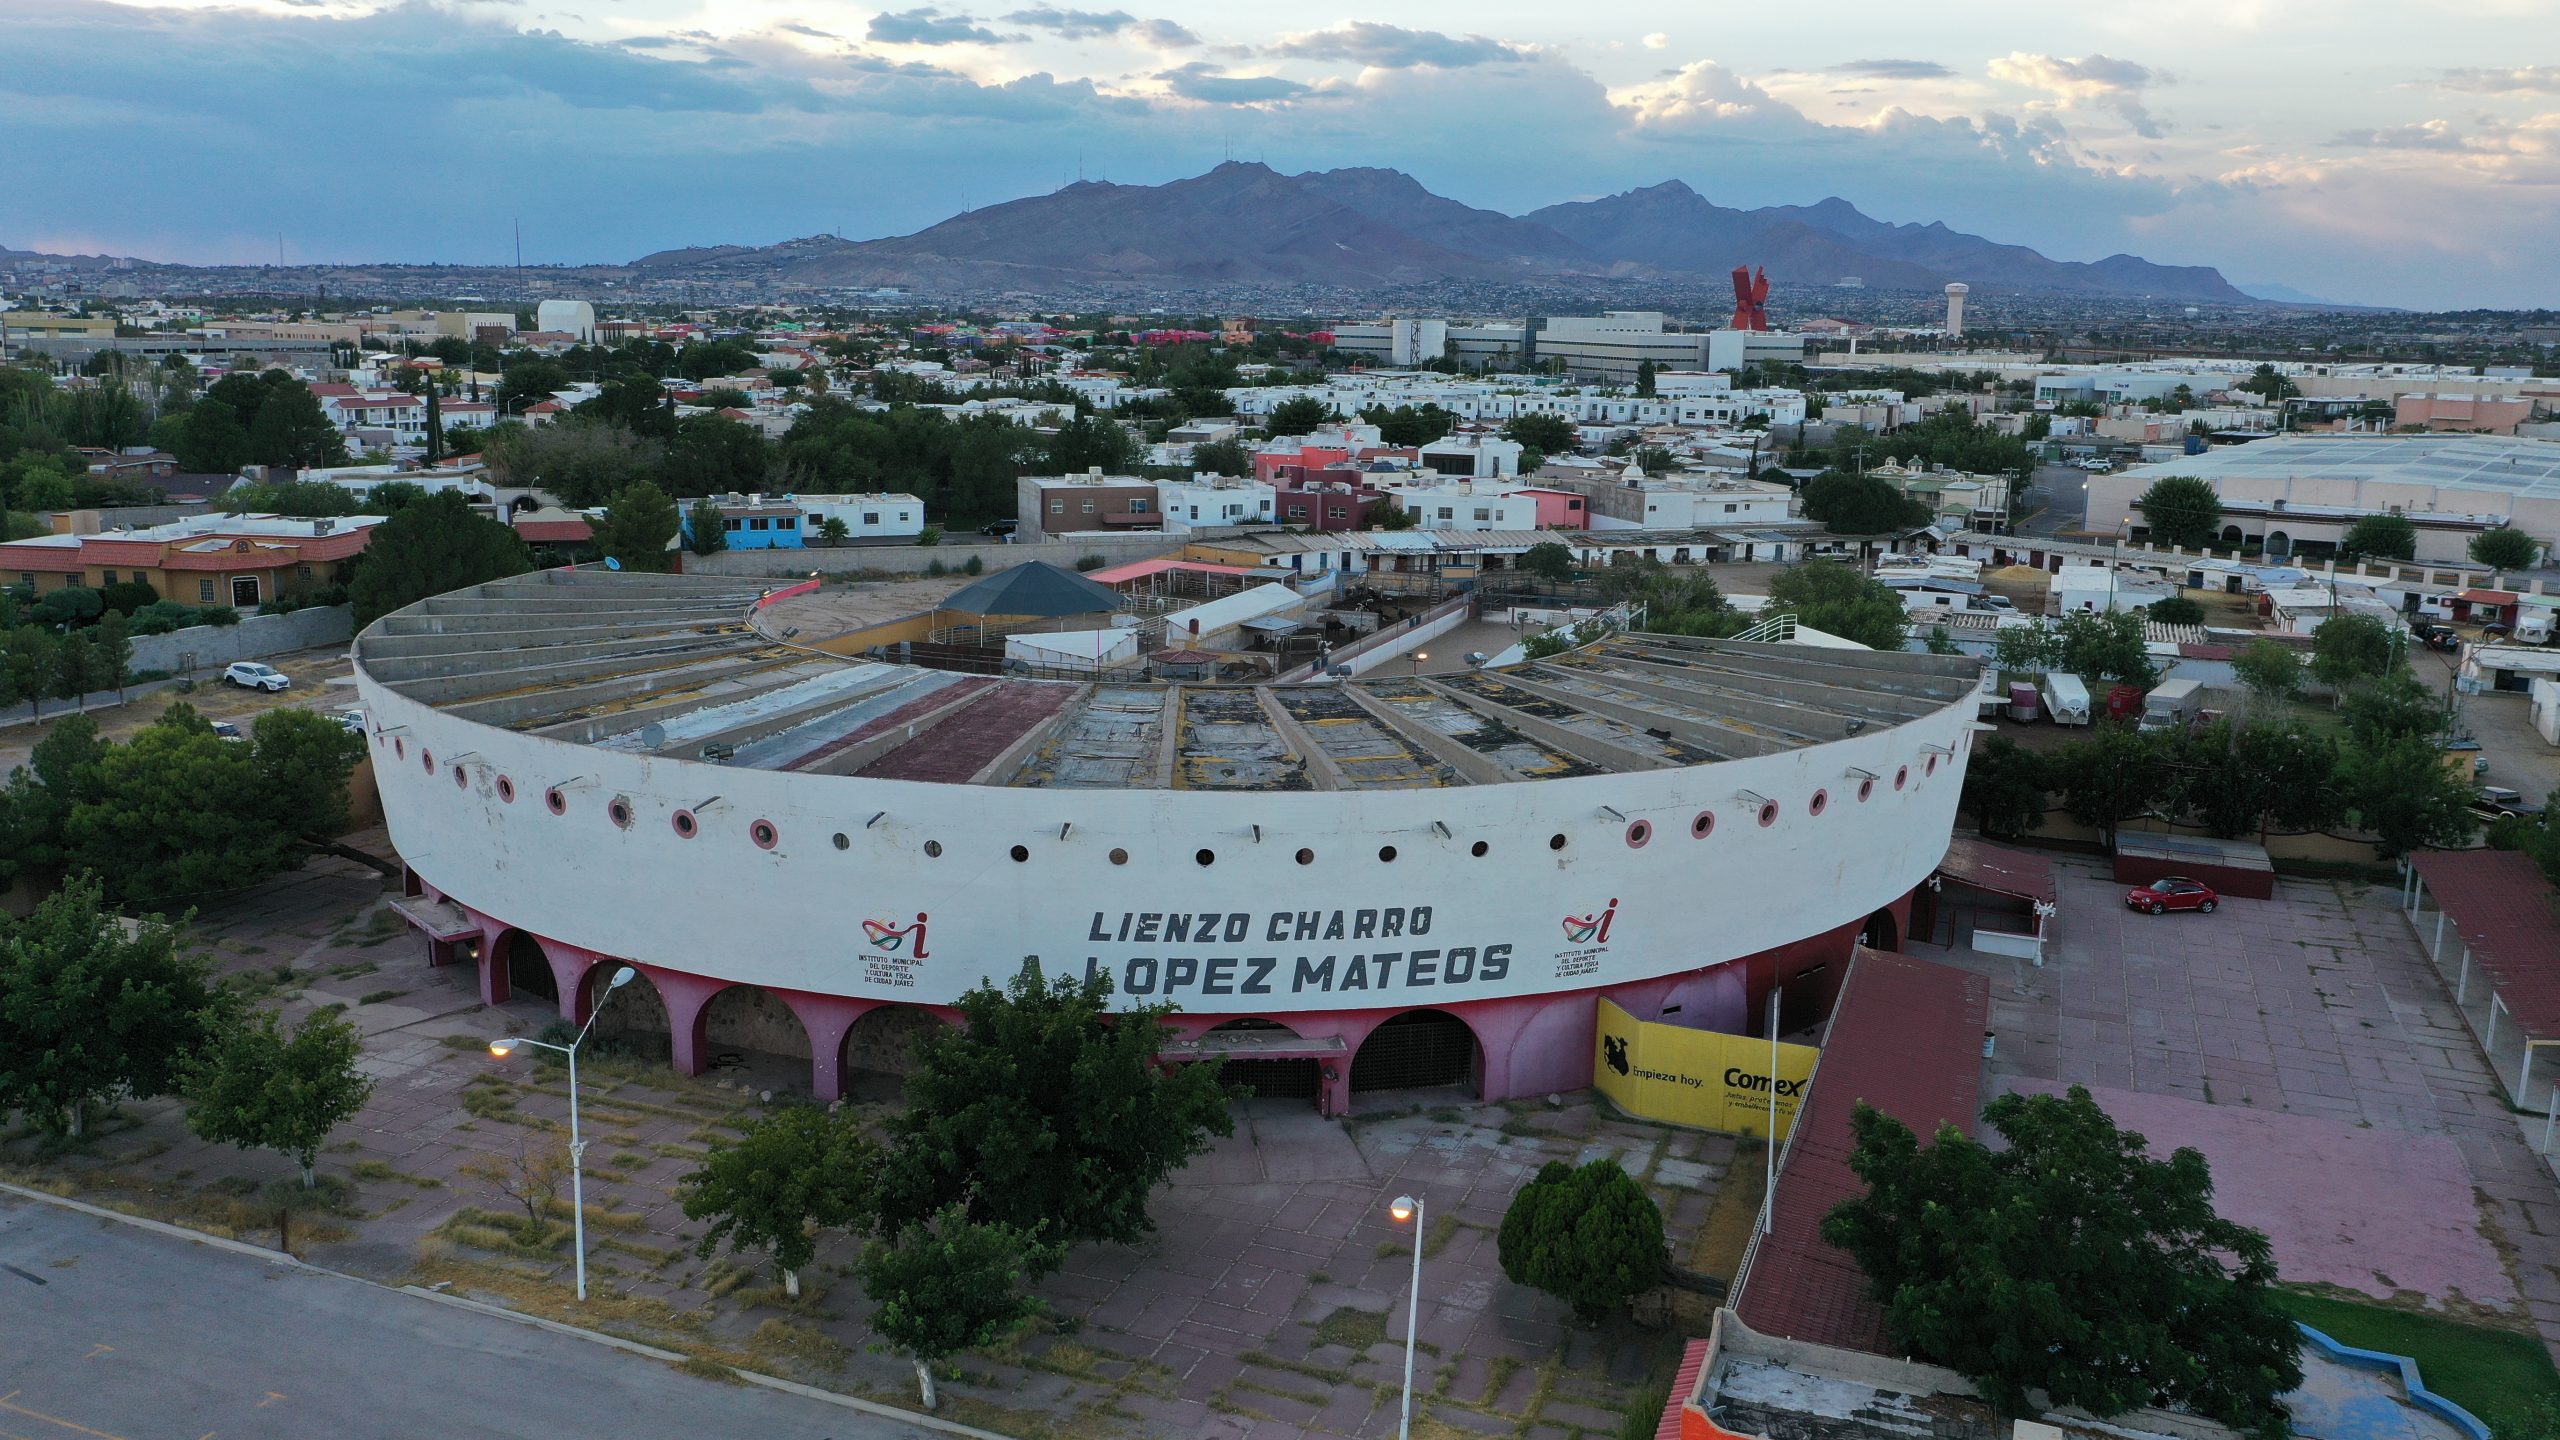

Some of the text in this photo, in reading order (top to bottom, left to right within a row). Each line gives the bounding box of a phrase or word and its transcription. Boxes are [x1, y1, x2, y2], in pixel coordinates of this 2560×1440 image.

[1088, 906, 1433, 943] LIENZO CHARRO
[1554, 946, 1609, 959] INSTITUTO MUNICIPAL
[858, 954, 924, 967] INSTITUTO MUNICIPAL
[1572, 955, 1595, 963] DEPORTE
[881, 964, 909, 972] DEPORTE
[1082, 956, 1277, 995] LOPEZ
[1291, 943, 1513, 993] MATEOS
[1561, 963, 1583, 971] CULTURA
[870, 970, 893, 978] CULTURA
[1563, 969, 1579, 977] CIUDAD
[873, 977, 893, 985] CIUDAD
[1633, 1065, 1704, 1088] Empieza hoy.
[1723, 1067, 1809, 1098] Comex
